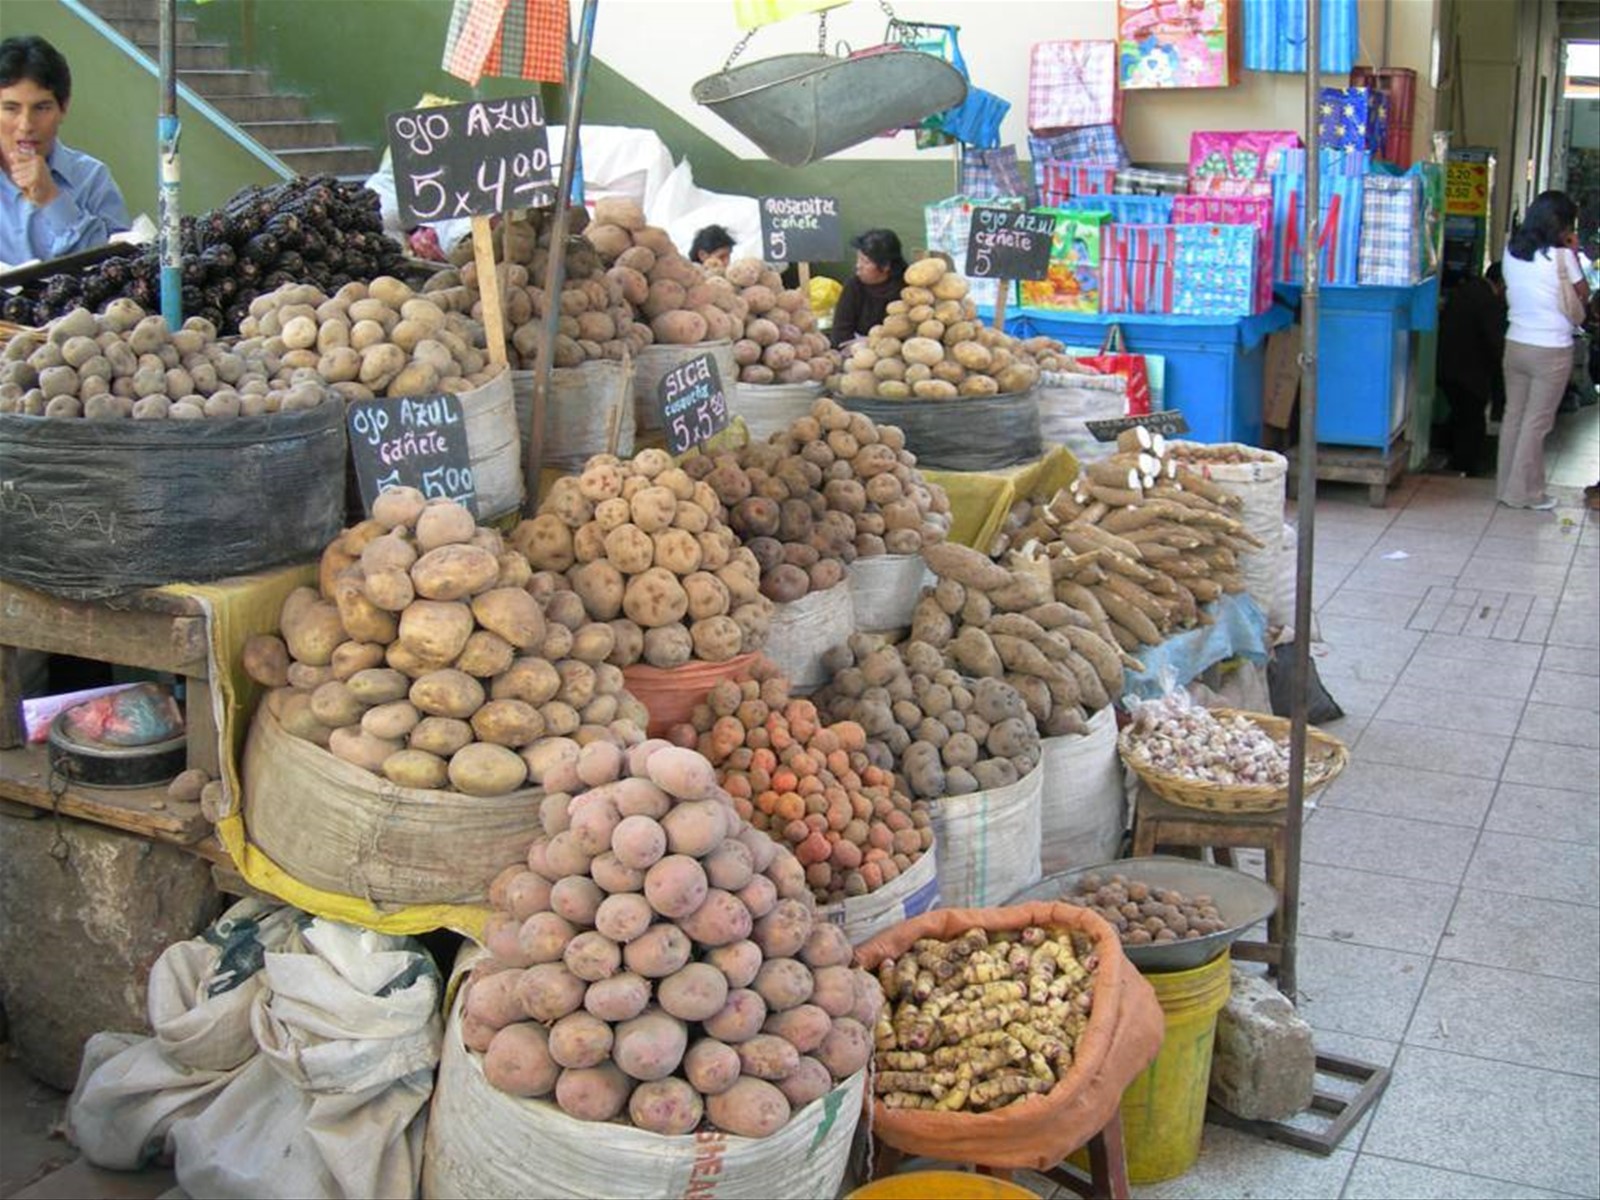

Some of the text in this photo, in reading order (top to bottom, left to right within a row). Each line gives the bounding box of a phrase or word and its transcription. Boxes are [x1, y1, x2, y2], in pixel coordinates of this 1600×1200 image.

[467, 96, 544, 137] AZUL
[770, 231, 787, 259] 5
[974, 248, 991, 276] 5
[401, 397, 458, 428] AZUL
